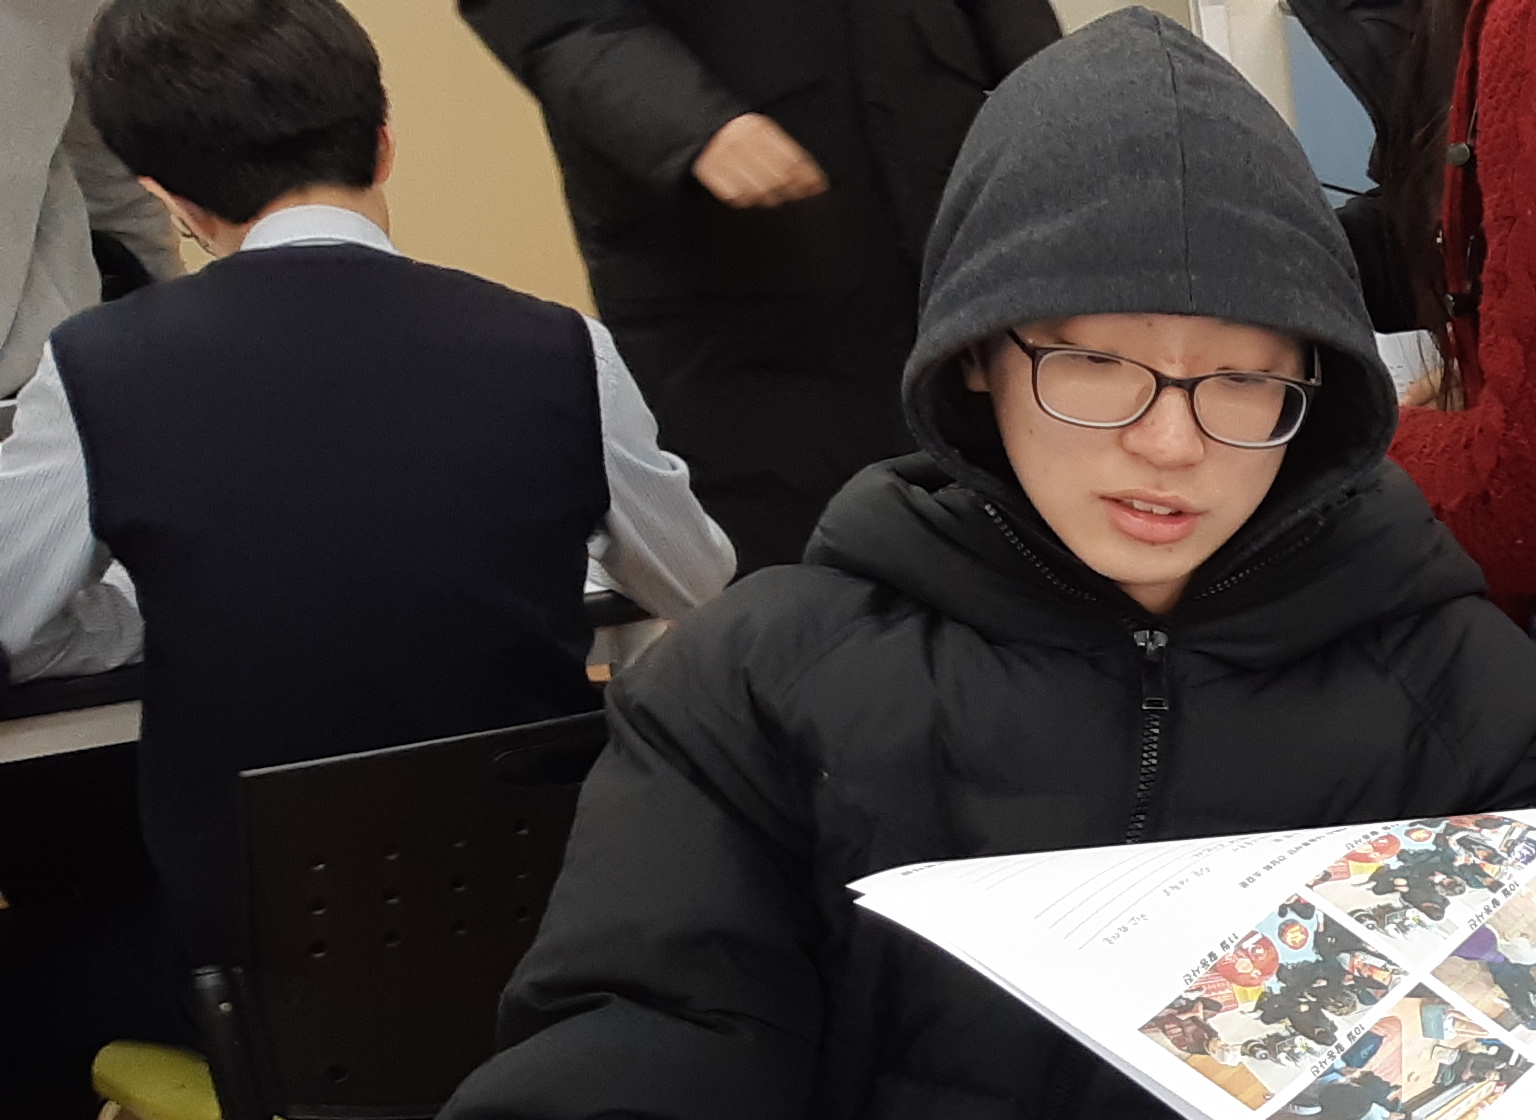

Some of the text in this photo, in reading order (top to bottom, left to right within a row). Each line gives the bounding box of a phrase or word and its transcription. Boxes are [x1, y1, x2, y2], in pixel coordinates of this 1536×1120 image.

[1467, 880, 1520, 931] 10월 활동사진
[1182, 932, 1239, 986] 11월 활동사진
[1310, 1023, 1366, 1077] 10월 활동사진
